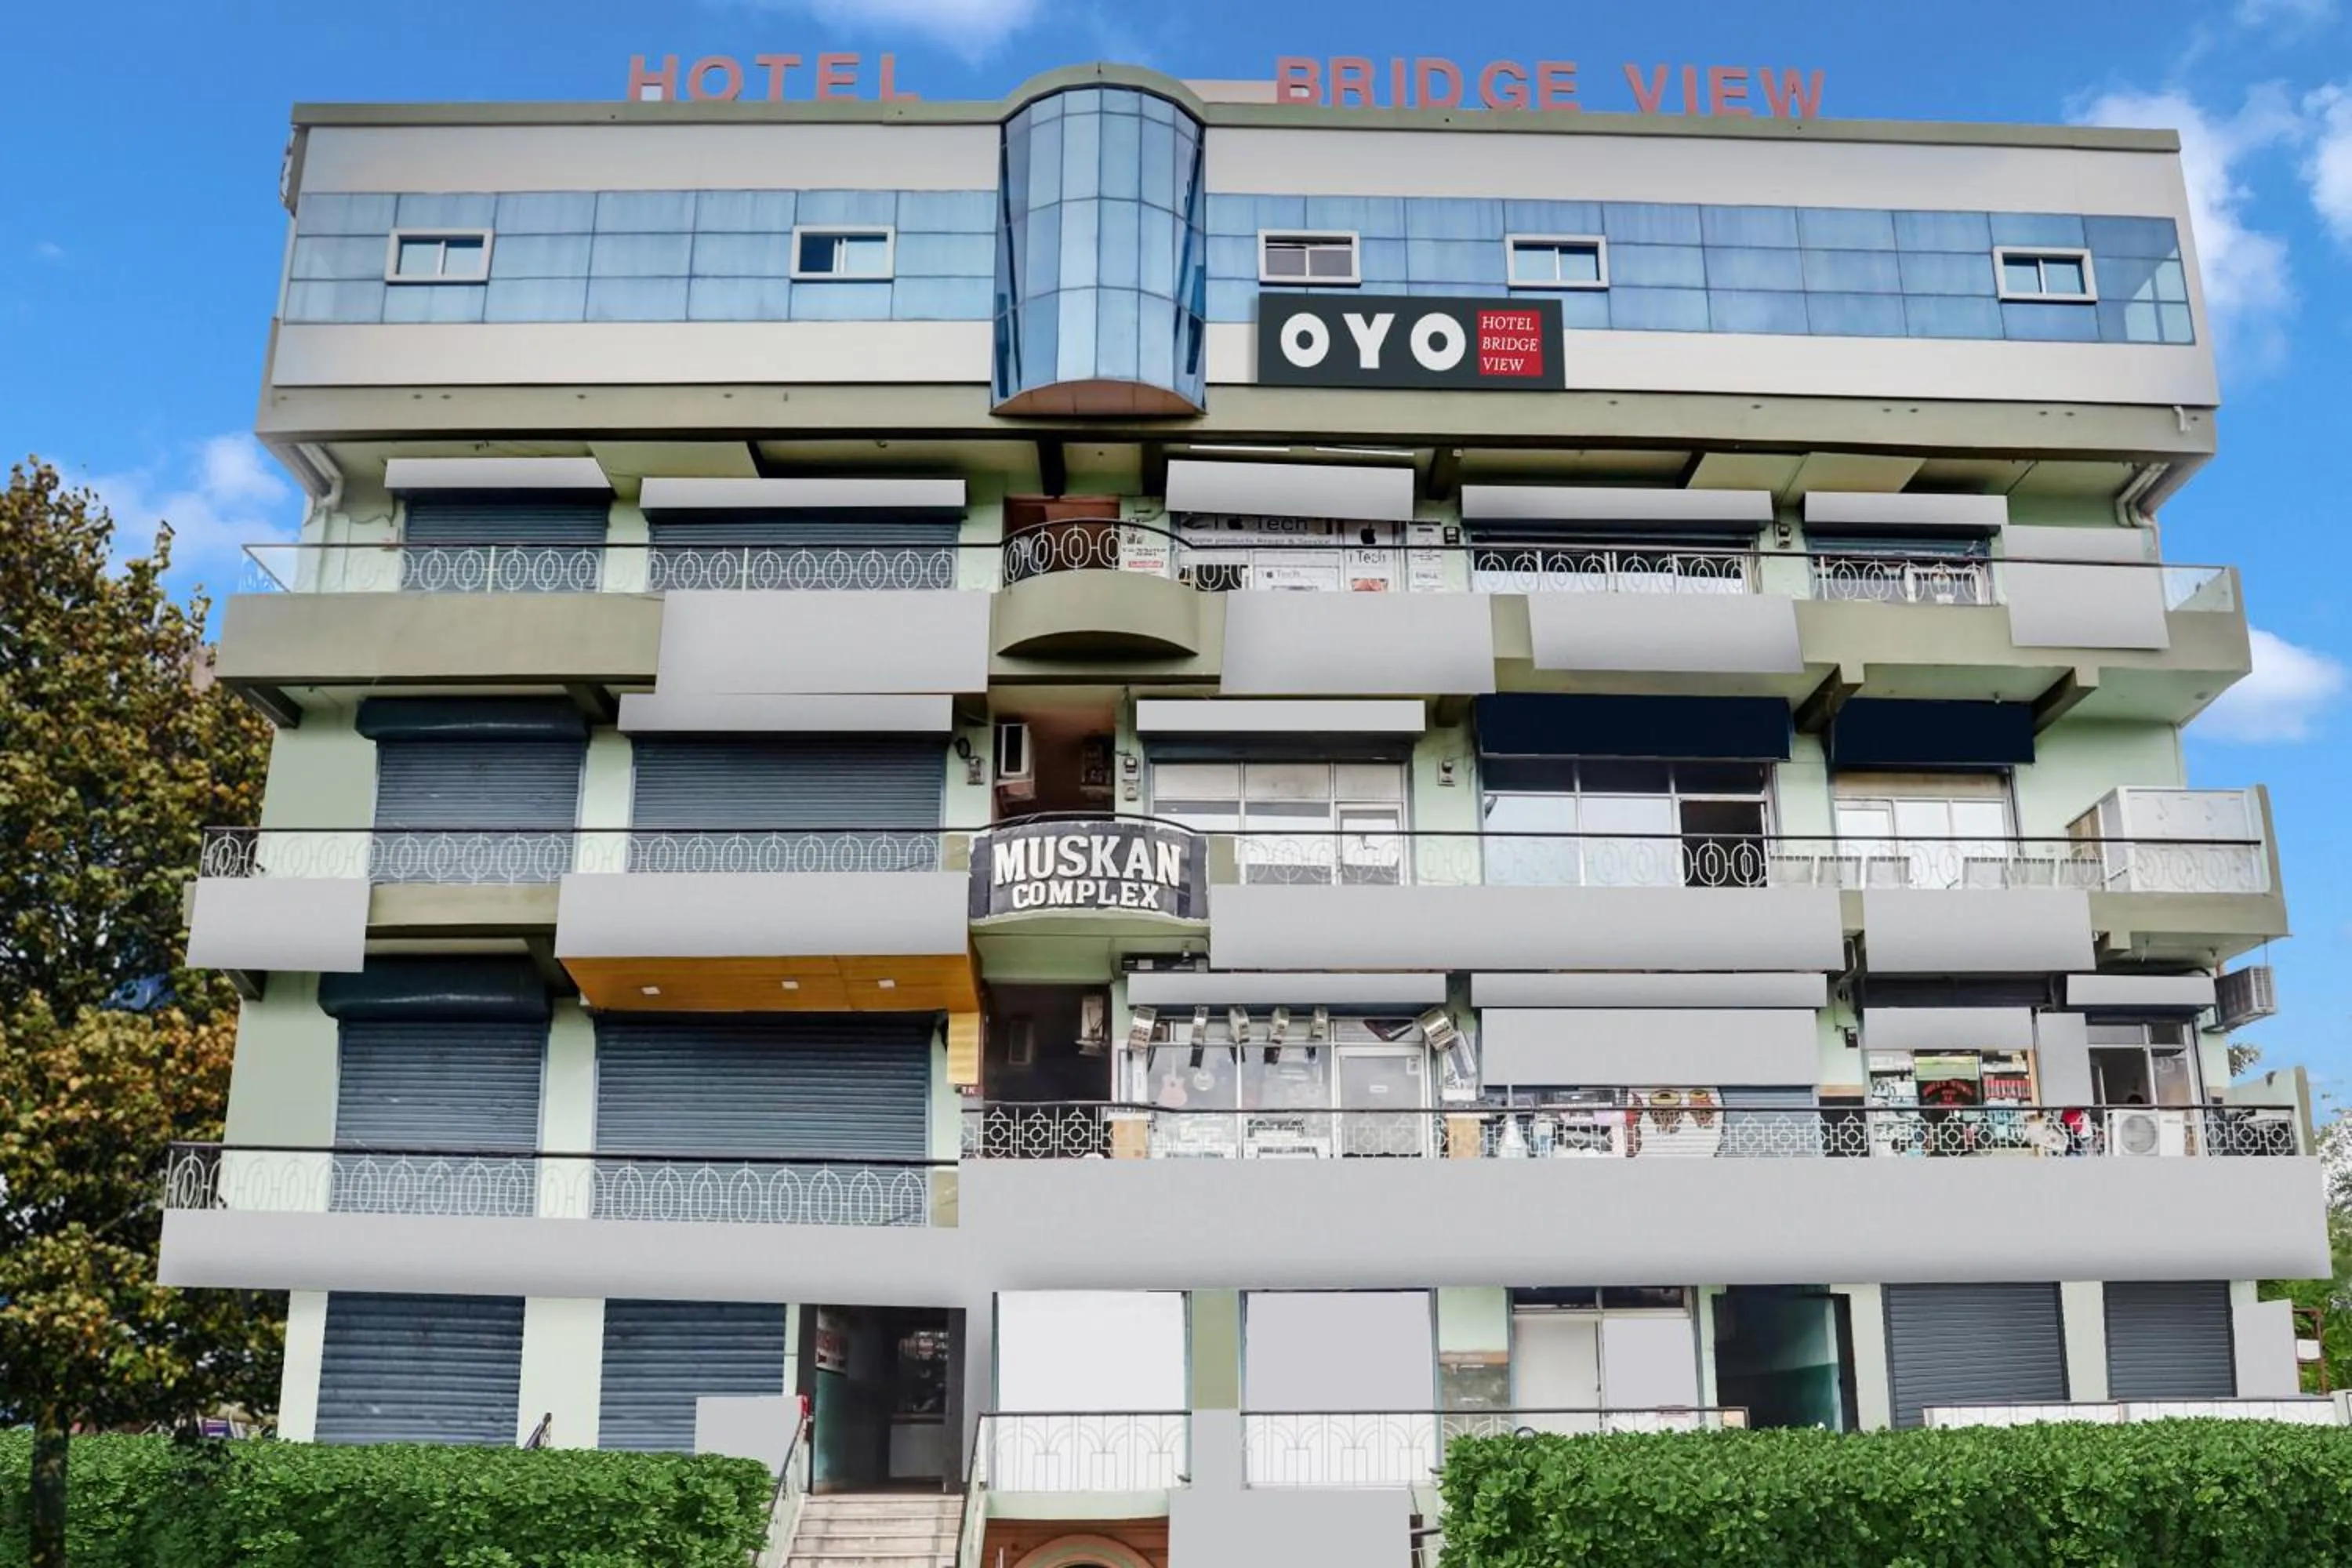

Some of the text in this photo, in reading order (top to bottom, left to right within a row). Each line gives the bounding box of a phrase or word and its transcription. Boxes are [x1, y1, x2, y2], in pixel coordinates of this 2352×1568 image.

[629, 52, 1825, 119] HOTEL BRIDGE VIEW
[1482, 316, 1534, 330] HOTEL
[1280, 312, 1466, 371] OYO
[1482, 336, 1538, 352] BRIDGE
[1483, 357, 1524, 372] VIEW
[1257, 516, 1308, 532] Tech
[1355, 550, 1387, 564] Tech
[993, 835, 1181, 887] MUSKAN
[1012, 879, 1160, 909] COMPLEX
